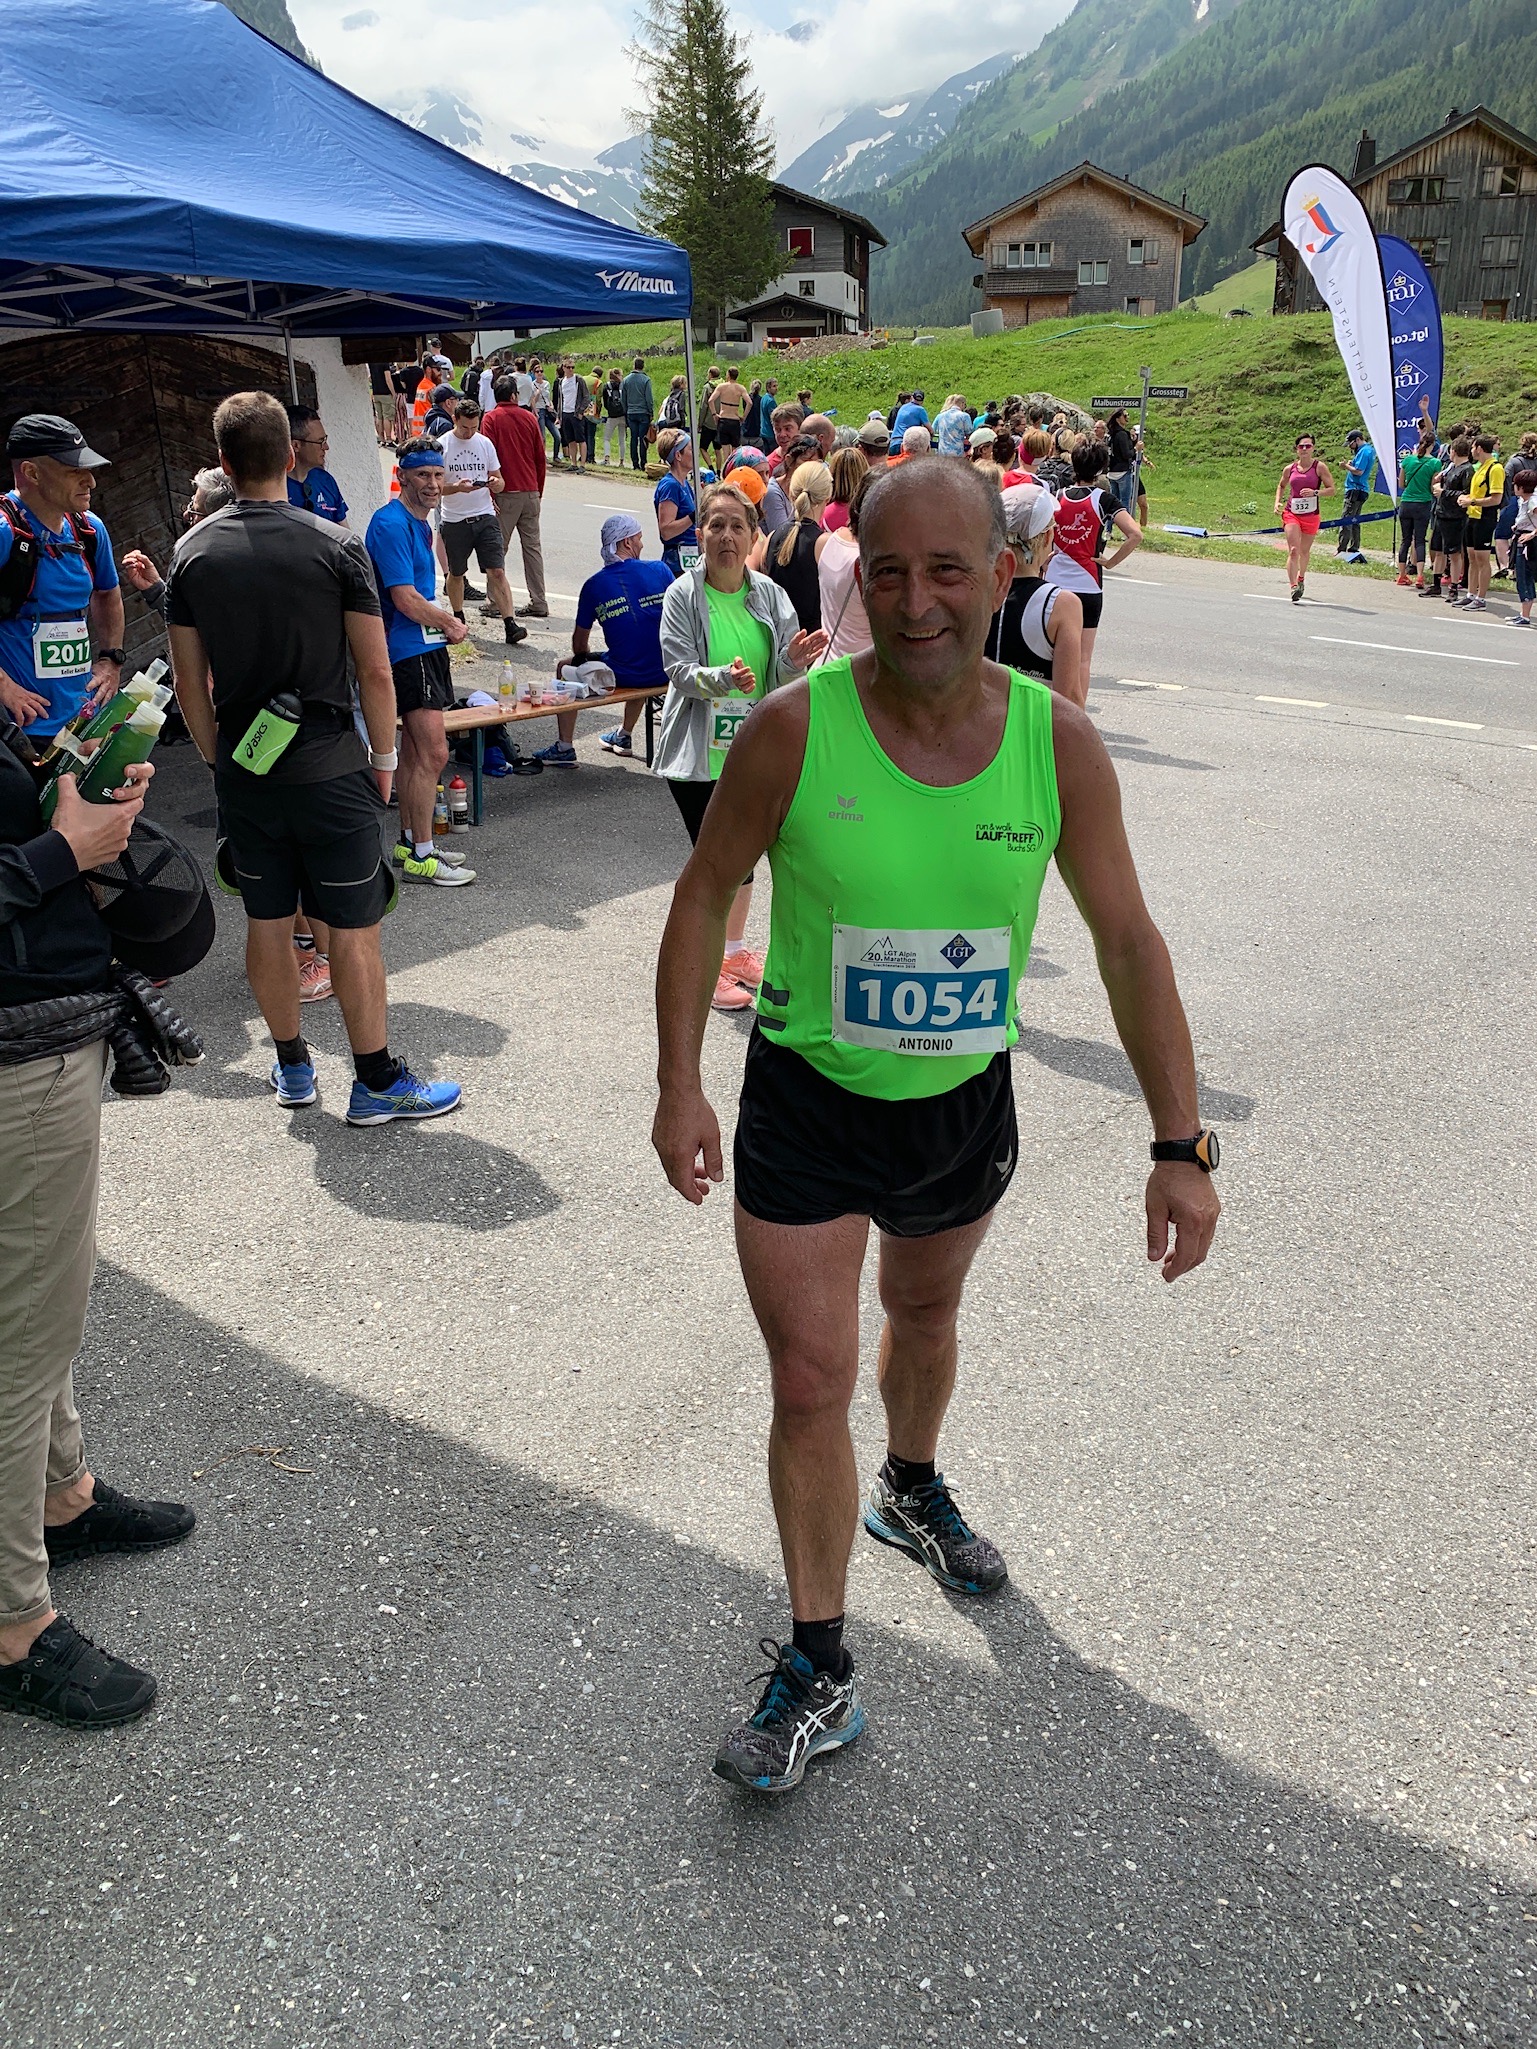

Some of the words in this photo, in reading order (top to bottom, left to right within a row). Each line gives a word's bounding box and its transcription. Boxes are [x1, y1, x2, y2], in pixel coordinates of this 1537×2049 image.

[1151, 388, 1185, 397] Grosssteg
[1093, 399, 1139, 407] Malbunstrasse
[448, 463, 486, 472] HOLLISTER
[606, 605, 630, 619] Vogel?
[251, 722, 268, 748] asics
[828, 811, 864, 822] erima
[976, 823, 989, 831] run
[995, 822, 1012, 831] walk
[976, 831, 1034, 844] LAUF-TREFF
[1007, 843, 1026, 852] Buchs
[1026, 844, 1036, 853] SG
[867, 952, 883, 962] 20.
[946, 946, 972, 958] LGT
[858, 978, 998, 1026] 1054
[898, 1037, 953, 1051] ANTONIO
